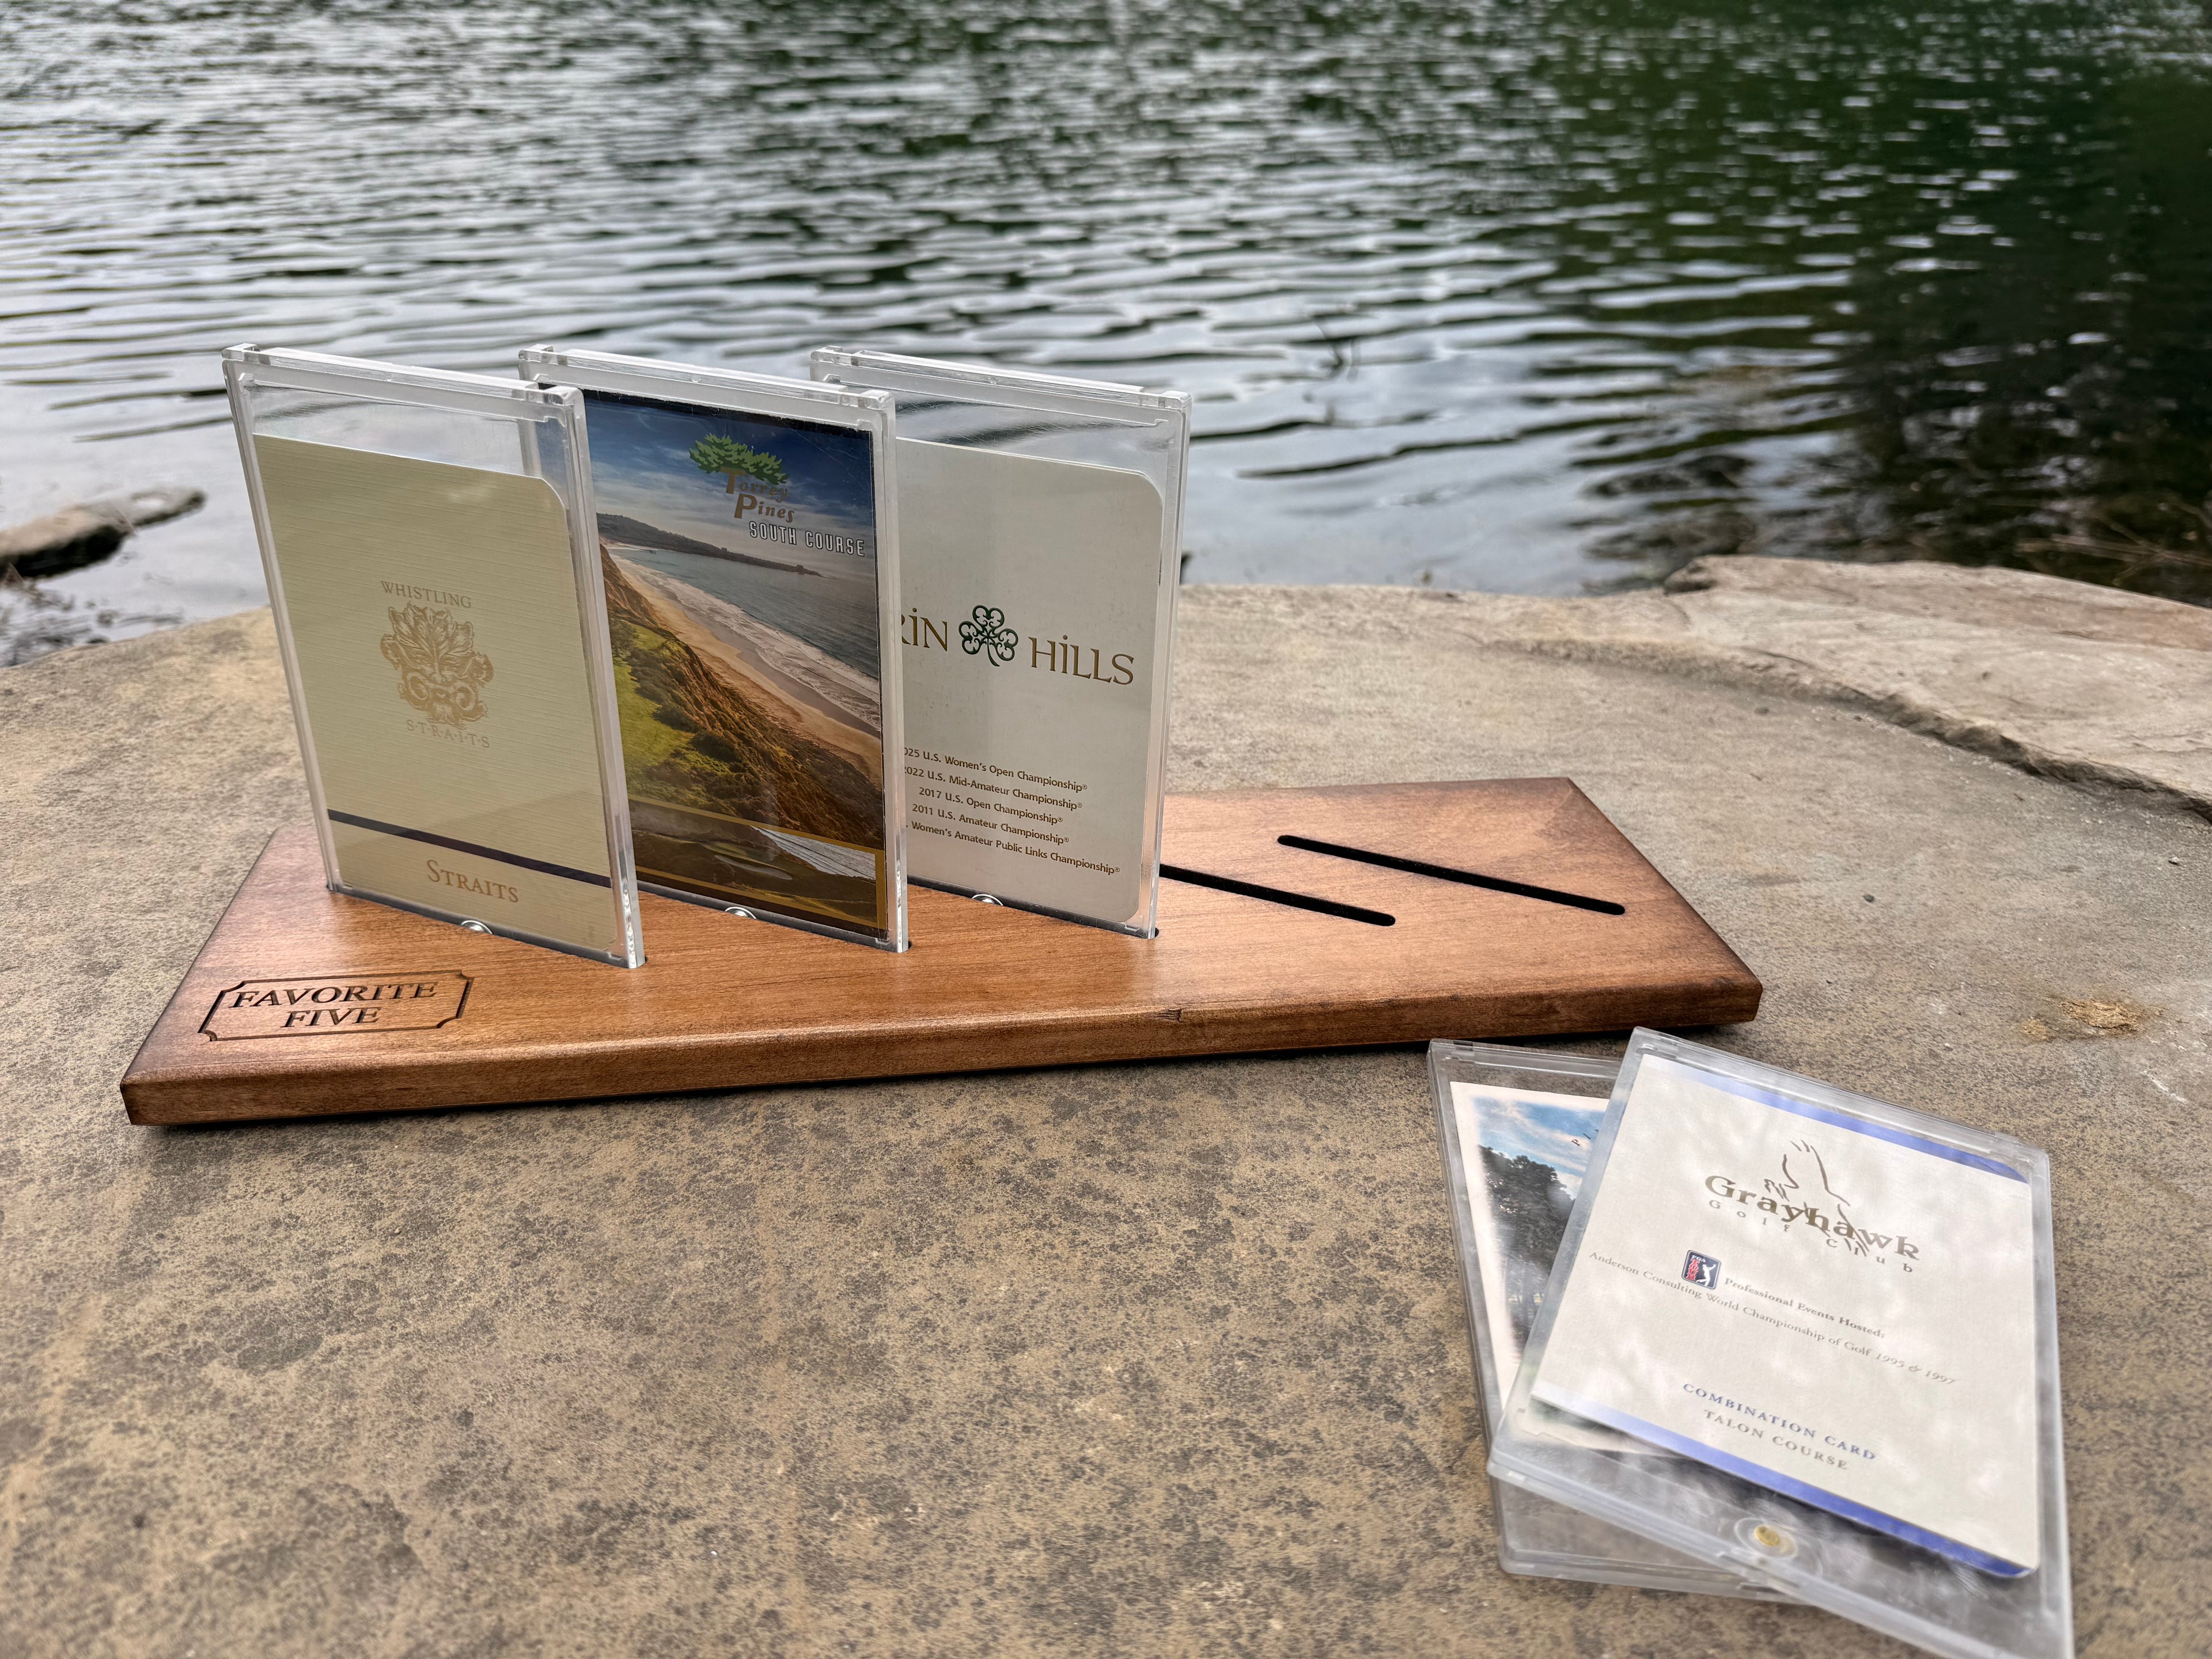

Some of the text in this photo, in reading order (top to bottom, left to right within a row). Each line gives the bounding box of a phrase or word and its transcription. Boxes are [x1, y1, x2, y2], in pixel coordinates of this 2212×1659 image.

[734, 494, 794, 522] Pines
[749, 521, 864, 556] SOUTH COURSE
[381, 581, 471, 608] WHISTLING
[923, 751, 941, 762] U.S.
[945, 756, 986, 771] Women's
[990, 766, 1013, 777] Open
[905, 767, 923, 777] 022
[928, 771, 945, 782] U.S.
[950, 775, 1010, 795] Mid-Amateur
[919, 787, 941, 798] 2017
[946, 793, 963, 804] U.S.
[967, 798, 990, 809] Open
[912, 804, 933, 815] 2011
[938, 809, 956, 820] U.S.
[959, 815, 998, 829] Amateur
[912, 821, 952, 836] Women's
[955, 831, 993, 846] Amateur
[997, 840, 1022, 853] Public
[1026, 847, 1047, 858] Links
[229, 982, 437, 1007] FAVORITE
[281, 1007, 381, 1027] FIVE
[1705, 1176, 1919, 1260] Grayhawk
[1725, 1278, 1793, 1306] Professional
[1798, 1302, 1835, 1321] Events
[1590, 1252, 1638, 1274] Anderson
[1643, 1271, 1701, 1299] Consulting
[1706, 1293, 1739, 1311] World
[1744, 1307, 1825, 1341] Championship
[1829, 1338, 1842, 1346] of
[1844, 1342, 1872, 1356] Golf
[1876, 1354, 1905, 1368] 1995
[1925, 1371, 1956, 1385] 1997
[1683, 1384, 1875, 1459] COMBINATION CARD
[1705, 1410, 1848, 1469] TALON COURSE
